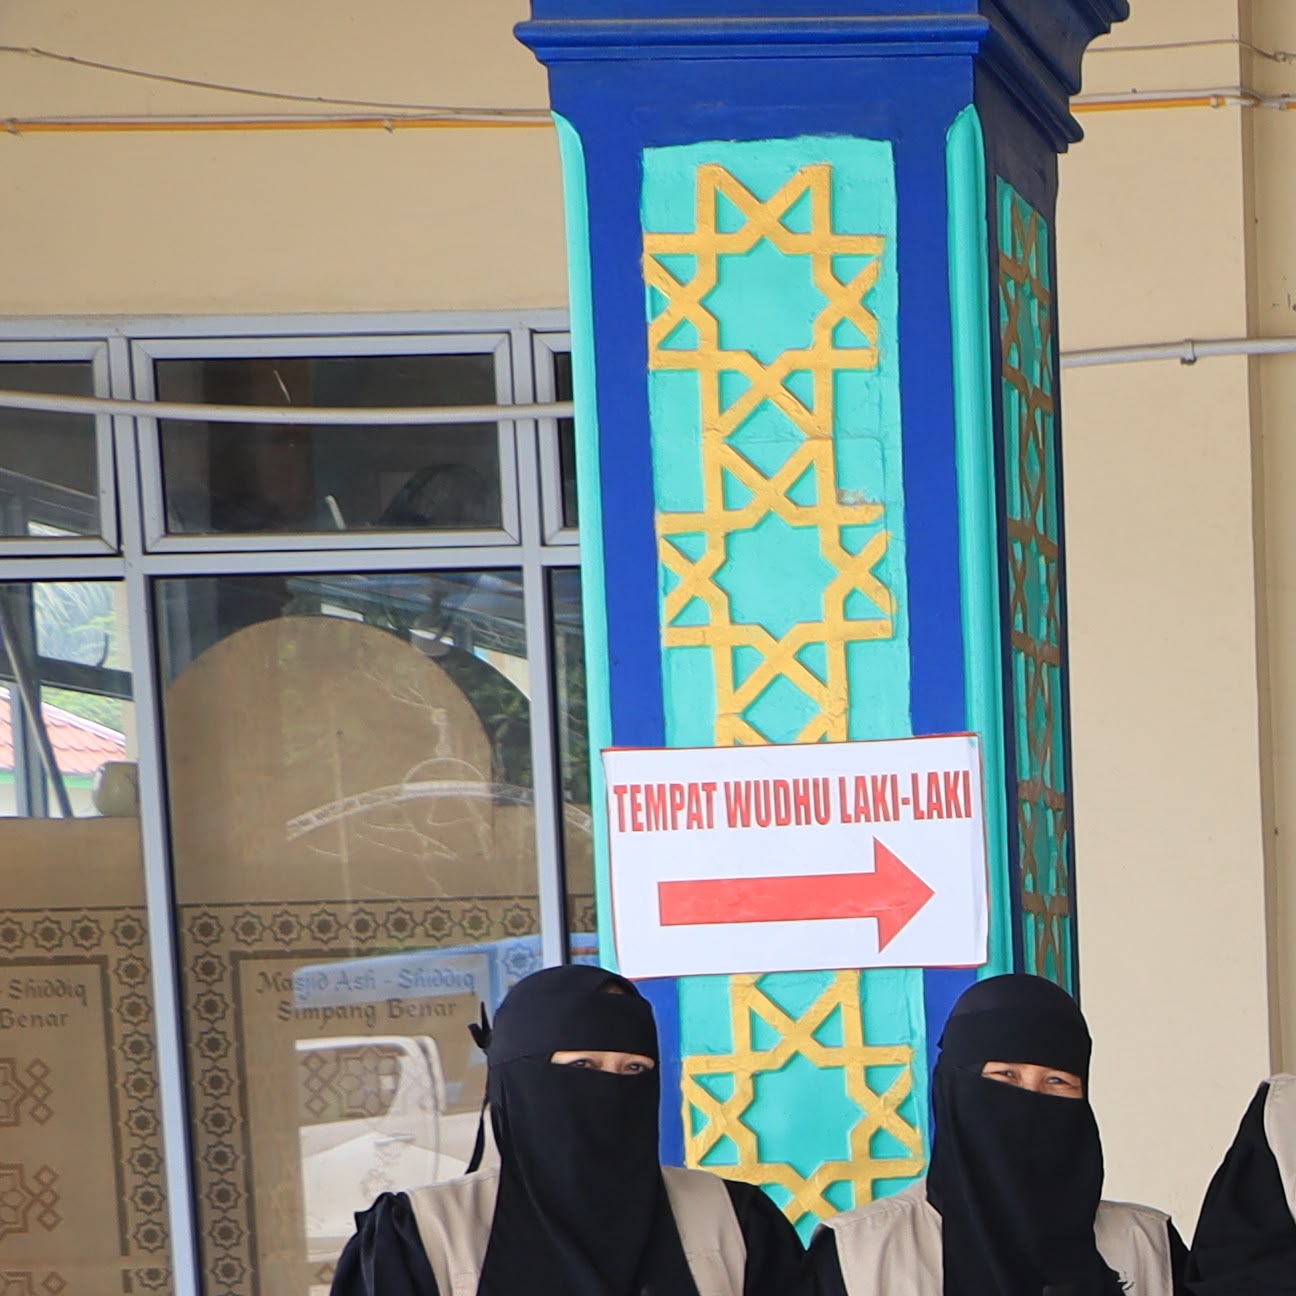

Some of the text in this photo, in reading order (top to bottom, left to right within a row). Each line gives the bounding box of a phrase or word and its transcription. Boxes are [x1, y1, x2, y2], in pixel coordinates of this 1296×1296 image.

[613, 770, 972, 833] TEMPAT WUDHU LAKI-LAKI
[256, 970, 328, 1001] Masjid
[334, 969, 376, 991] Ash
[398, 967, 476, 995] Shiddiq
[277, 998, 457, 1029] Simpang Benar
